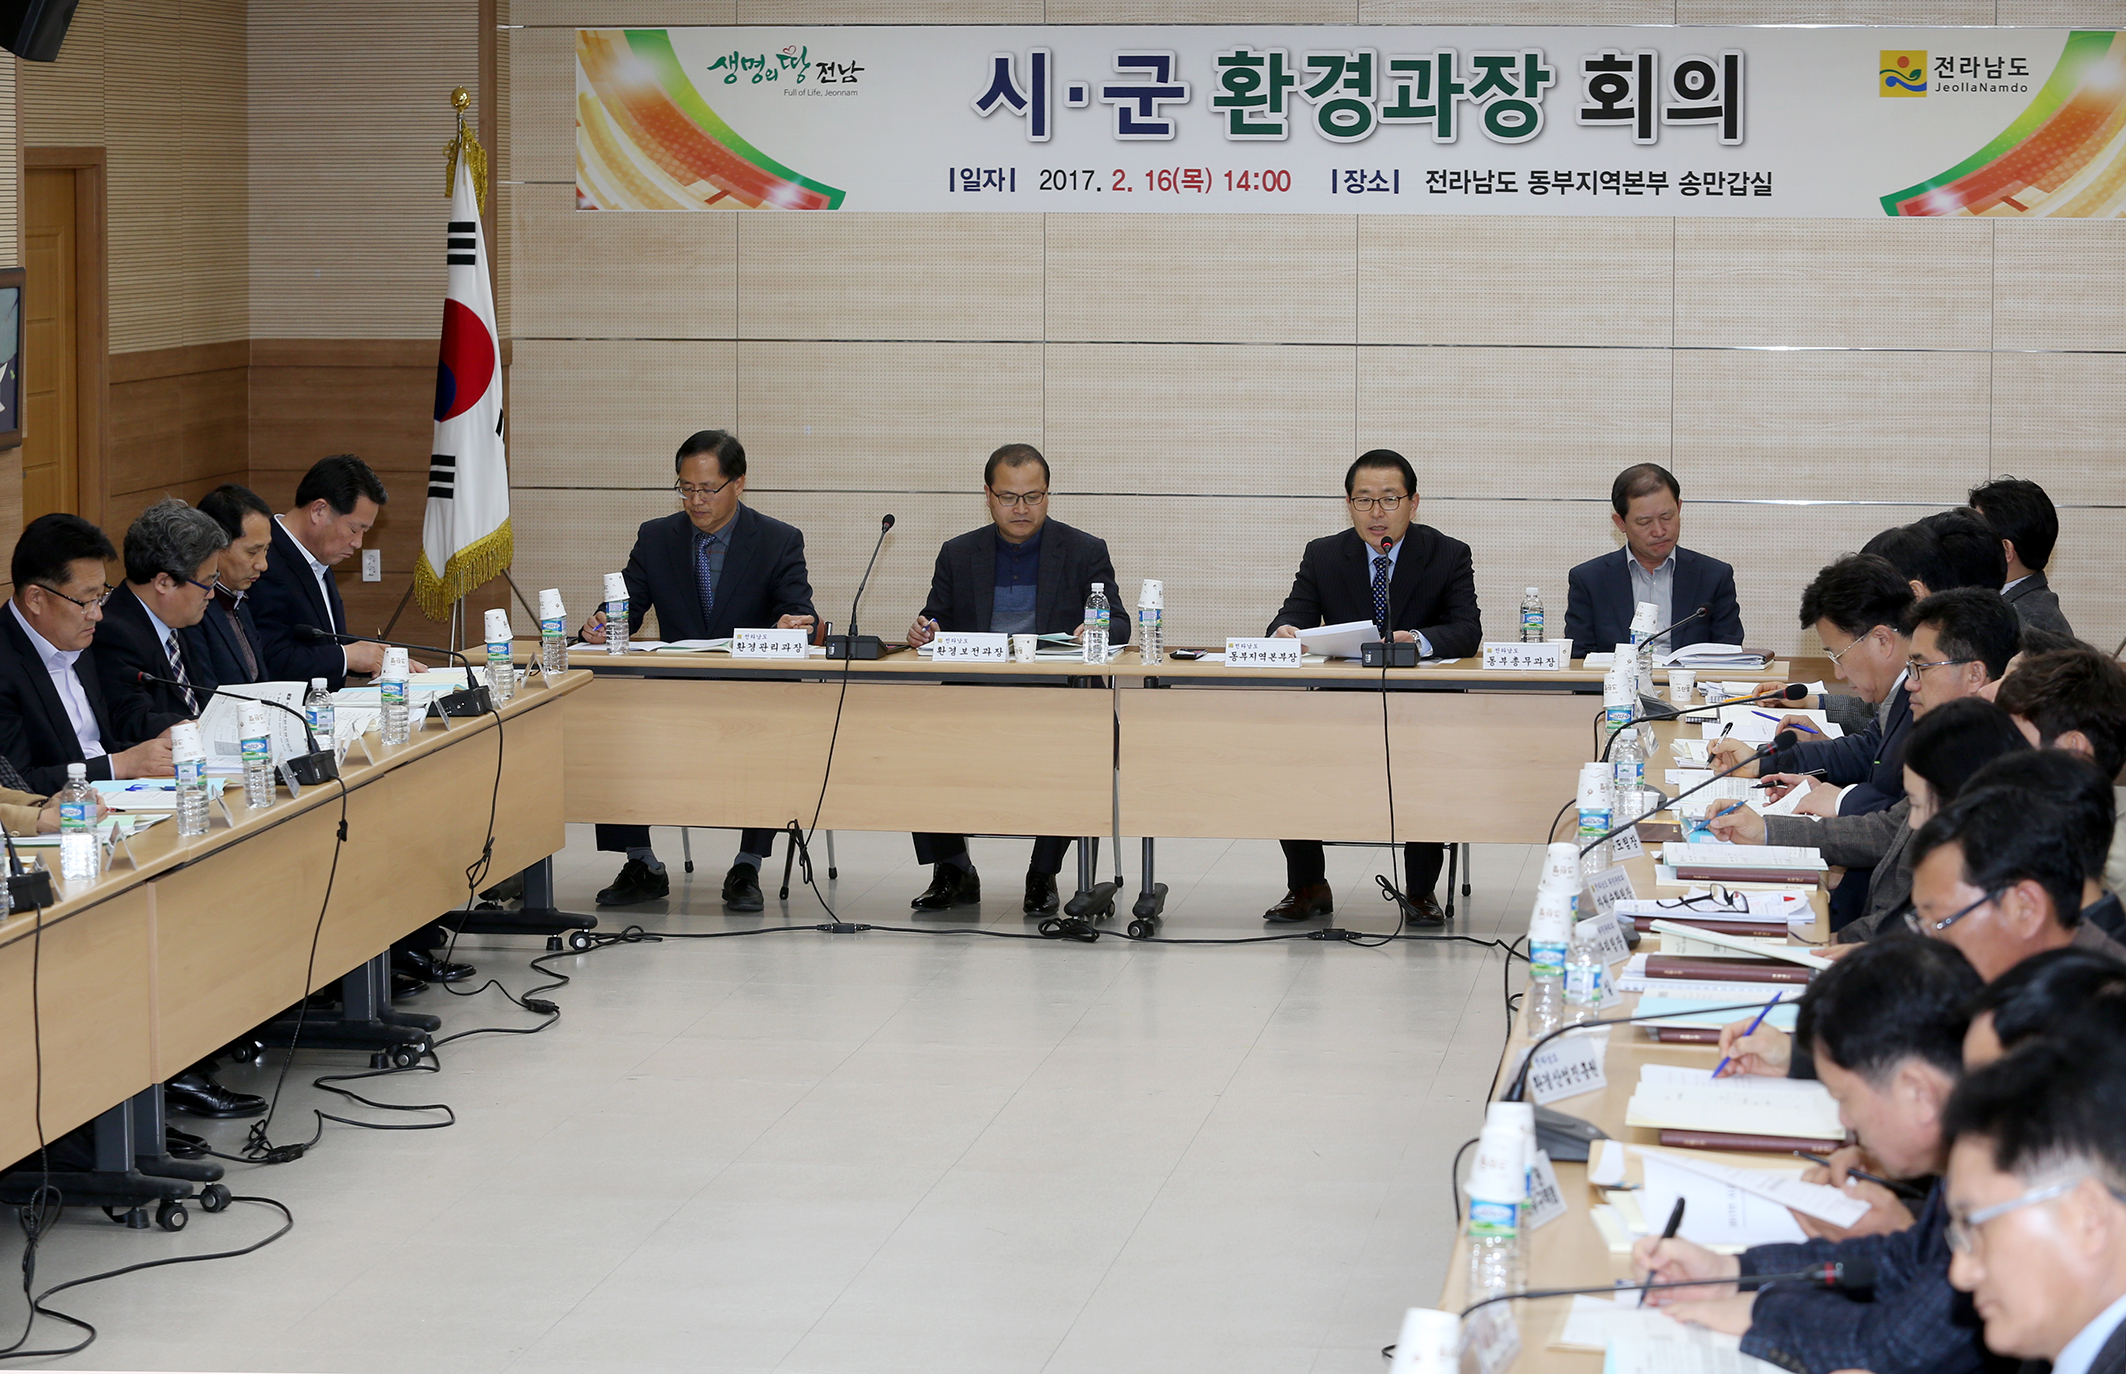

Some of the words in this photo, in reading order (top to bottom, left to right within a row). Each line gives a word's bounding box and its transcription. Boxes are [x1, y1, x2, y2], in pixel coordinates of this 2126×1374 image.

[707, 51, 778, 84] 생명의
[776, 46, 811, 84] 땅
[816, 60, 865, 84] 전남
[1934, 56, 2029, 79] 전라남도
[807, 89, 823, 97] Life,
[1935, 82, 2028, 93] JeollaNamdo
[975, 52, 1185, 137] 시·군
[1213, 50, 1551, 138] 환경과장
[1581, 53, 1739, 139] 회의
[1039, 169, 1101, 192] 2017.
[1112, 169, 1133, 192] 2.
[1145, 167, 1213, 194] 16(목)
[1223, 169, 1291, 192] 14:00
[1425, 169, 1518, 194] 전라남도
[1528, 169, 1669, 195] 동부지역본부
[1678, 170, 1773, 196] 송만갑실
[736, 641, 803, 653] 환경관리과장
[936, 645, 1004, 657] 환경보전과장
[1229, 651, 1298, 663] 동부지역본부장
[1487, 655, 1556, 667] 동부총무과장
